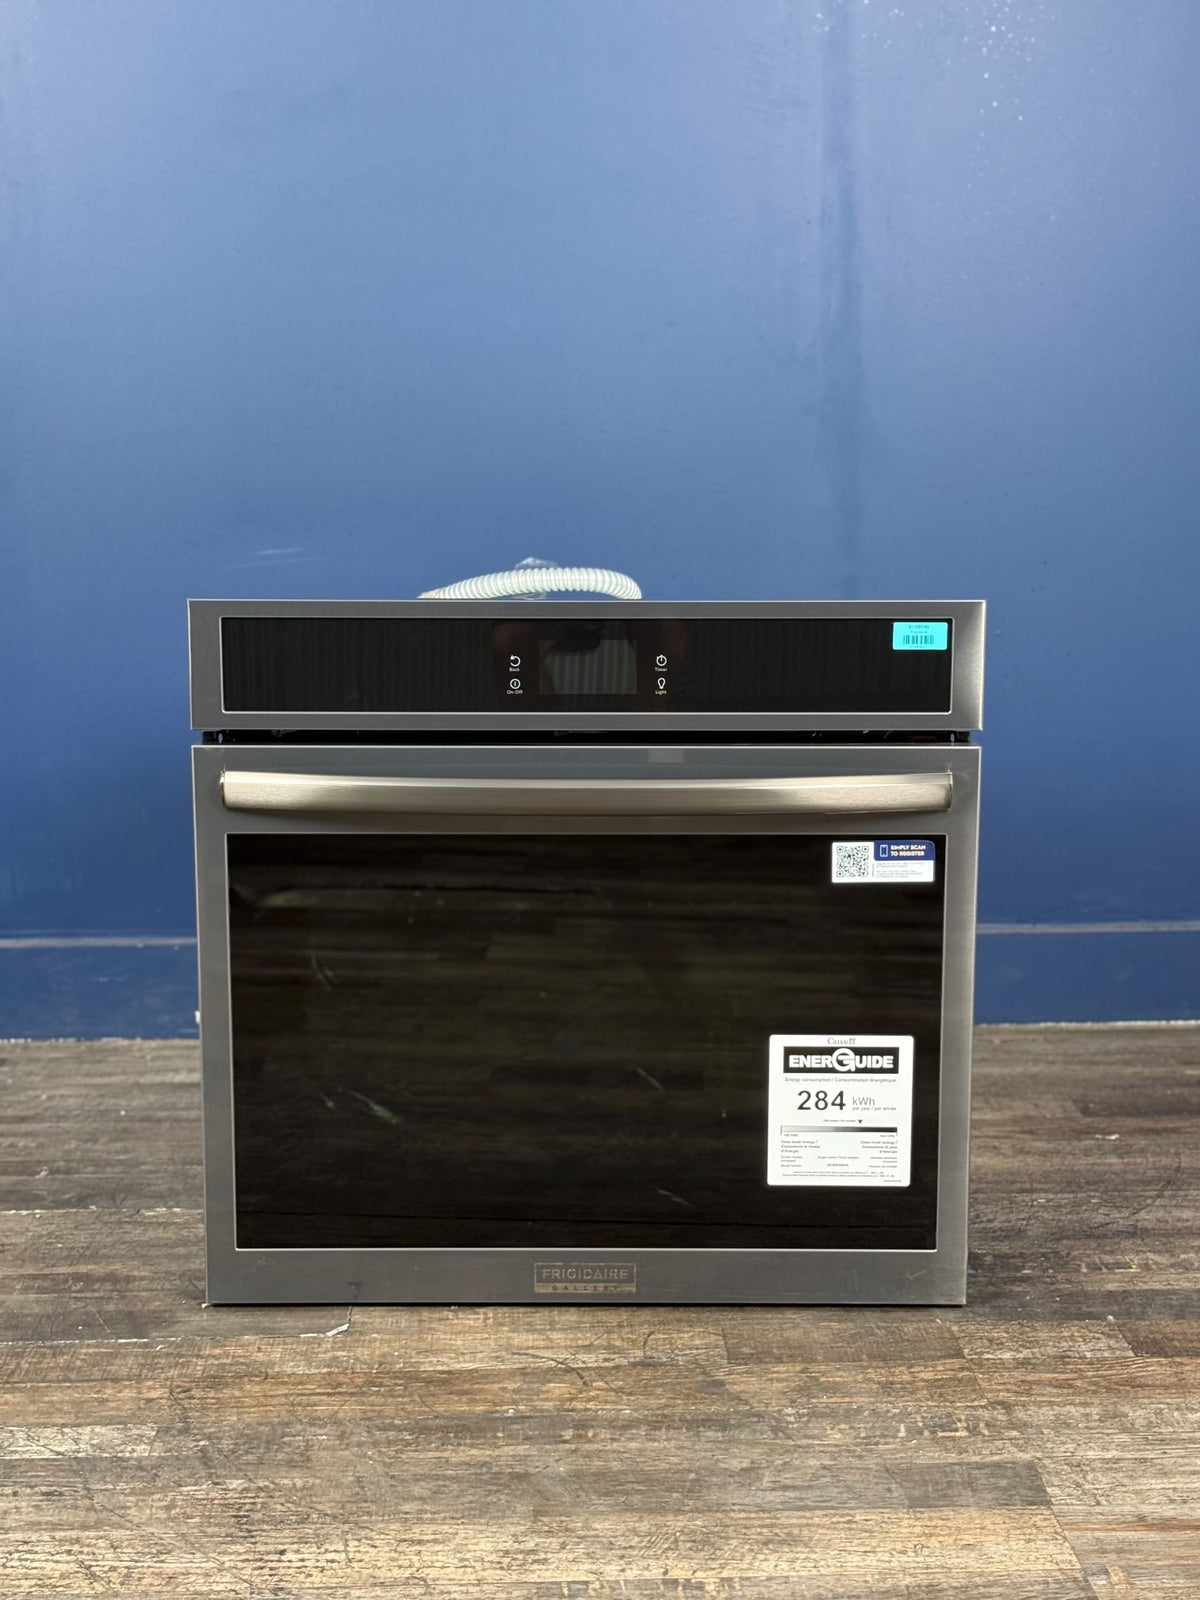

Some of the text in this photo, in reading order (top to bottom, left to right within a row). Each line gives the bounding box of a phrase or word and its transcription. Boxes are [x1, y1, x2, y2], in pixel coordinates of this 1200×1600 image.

[797, 1090, 875, 1111] 284 kWh
[542, 1268, 629, 1279] FRIGIDAIRE
